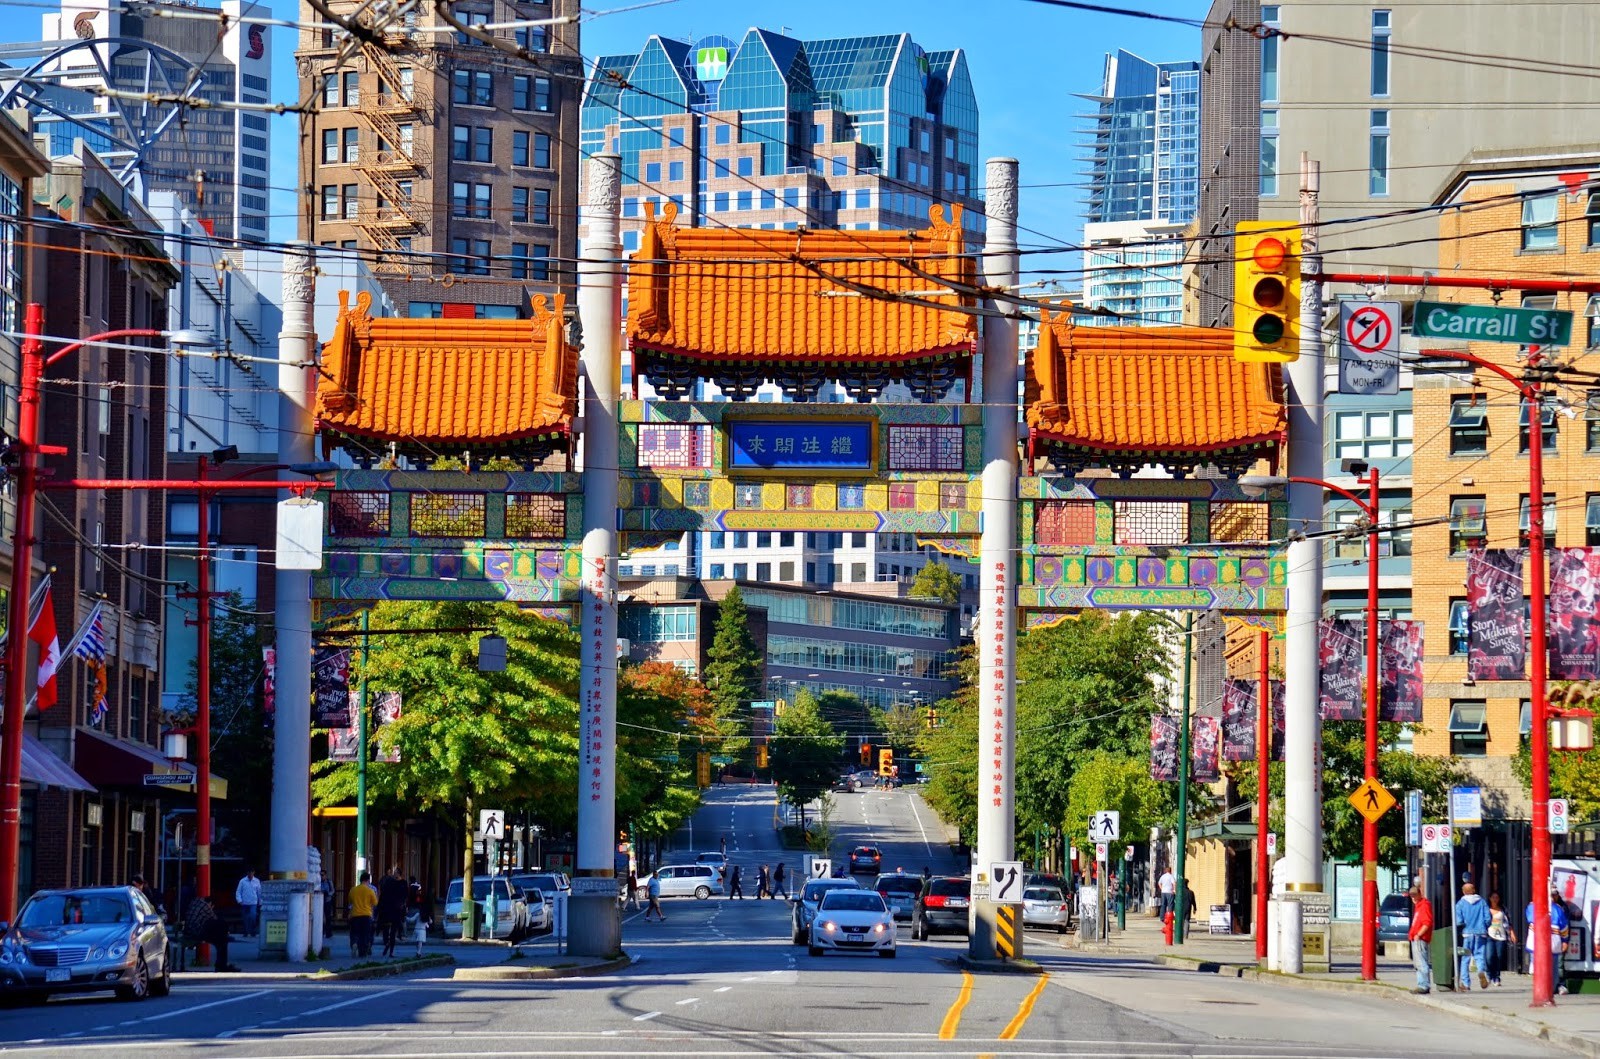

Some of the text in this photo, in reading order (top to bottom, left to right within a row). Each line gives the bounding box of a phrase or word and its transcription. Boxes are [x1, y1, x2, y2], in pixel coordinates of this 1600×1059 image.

[1427, 308, 1559, 339] Carrall St
[1472, 619, 1497, 633] Story
[1479, 624, 1518, 642] Making
[1489, 636, 1513, 649] Since
[1503, 643, 1521, 655] 1885
[1322, 673, 1341, 684] Story
[1328, 677, 1358, 690] Making
